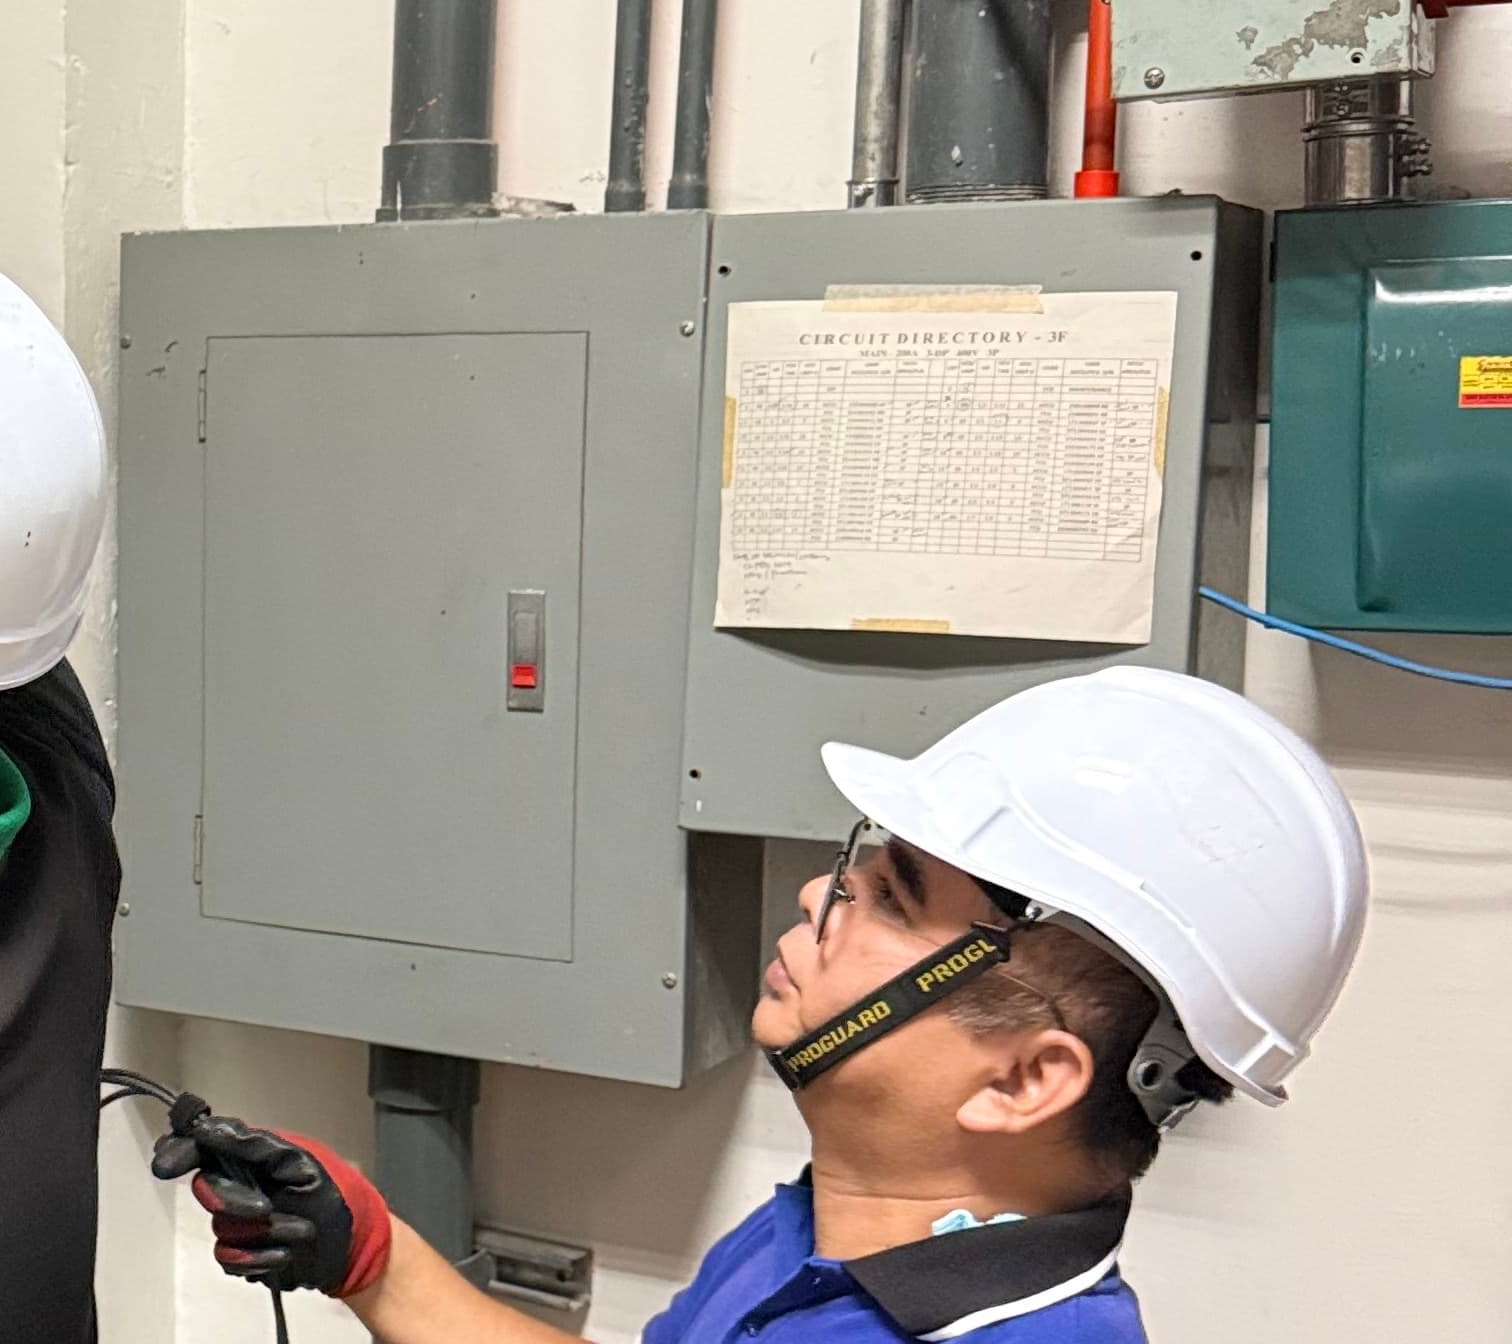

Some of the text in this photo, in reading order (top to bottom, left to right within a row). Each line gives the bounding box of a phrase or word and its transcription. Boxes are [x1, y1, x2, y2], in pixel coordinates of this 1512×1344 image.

[799, 333, 890, 345] CIRCUIT
[897, 331, 1027, 344] DIRECTORY
[1047, 331, 1068, 343] 3F
[788, 1000, 892, 1073] PROGUARD
